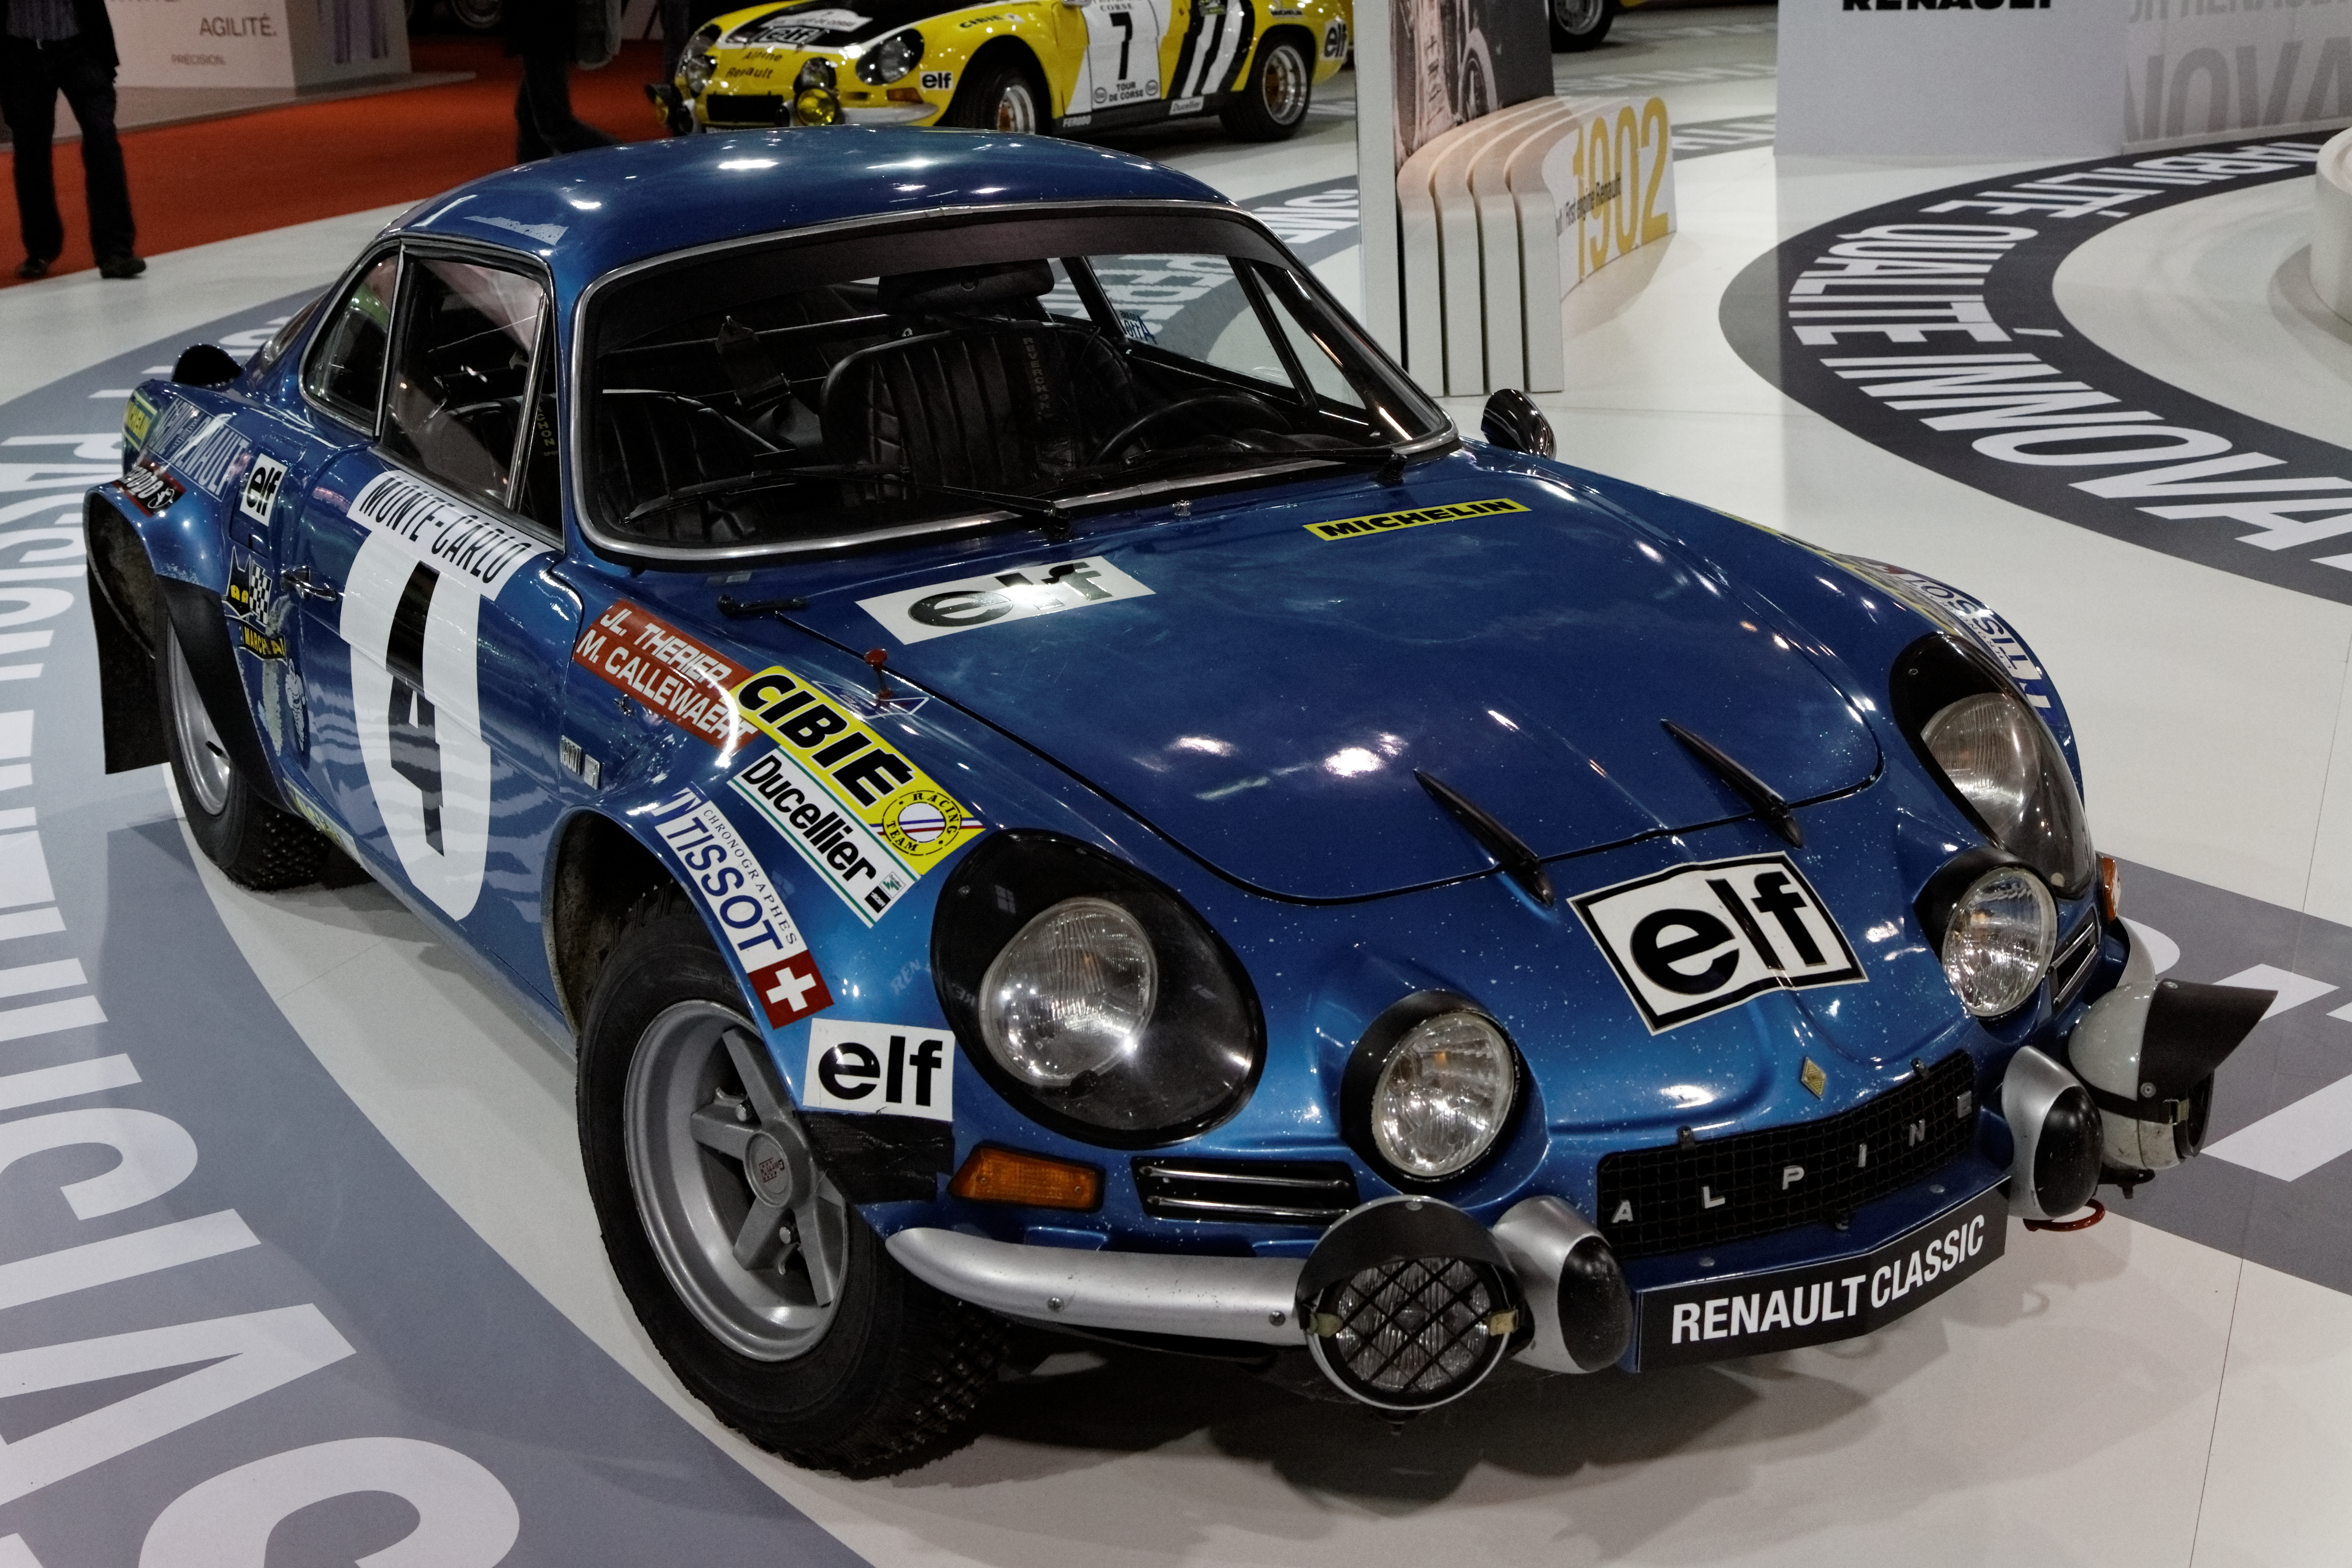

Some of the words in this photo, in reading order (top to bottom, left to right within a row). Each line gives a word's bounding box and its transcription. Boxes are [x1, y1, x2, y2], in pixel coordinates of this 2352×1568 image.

[199, 13, 277, 37] AGILITÉ.
[1110, 11, 1132, 80] 7
[1323, 23, 1346, 58] elf
[922, 72, 951, 88] elf
[1116, 81, 1136, 91] TOUR
[1120, 89, 1144, 100] CORSE
[1572, 97, 1669, 280] 1902
[1918, 142, 2322, 219] ABILITÉ
[1788, 223, 2063, 346] QUALITÉ
[169, 415, 250, 496] RENAULT
[246, 467, 283, 516] elf
[1818, 352, 2352, 572] INNOVA
[359, 476, 532, 584] MONTE-CARLO
[1325, 500, 1519, 537] MICHELIN
[909, 562, 1114, 628] elf
[577, 630, 600, 662] M.
[601, 609, 629, 637] JL.
[634, 624, 733, 689] THERIER
[735, 674, 916, 808] CIBIE
[740, 752, 876, 882] Ducellier
[886, 820, 919, 852] TEAM
[912, 791, 959, 834] RACING
[678, 817, 784, 953] TISSOT
[703, 809, 798, 945] CHRONOGRAPHES
[1629, 871, 1827, 995] elf
[819, 1034, 945, 1109] elf
[1612, 1090, 1973, 1224] ALPINE
[1671, 1275, 1867, 1344] RENAULT
[1870, 1214, 1986, 1309] CLASSIC
